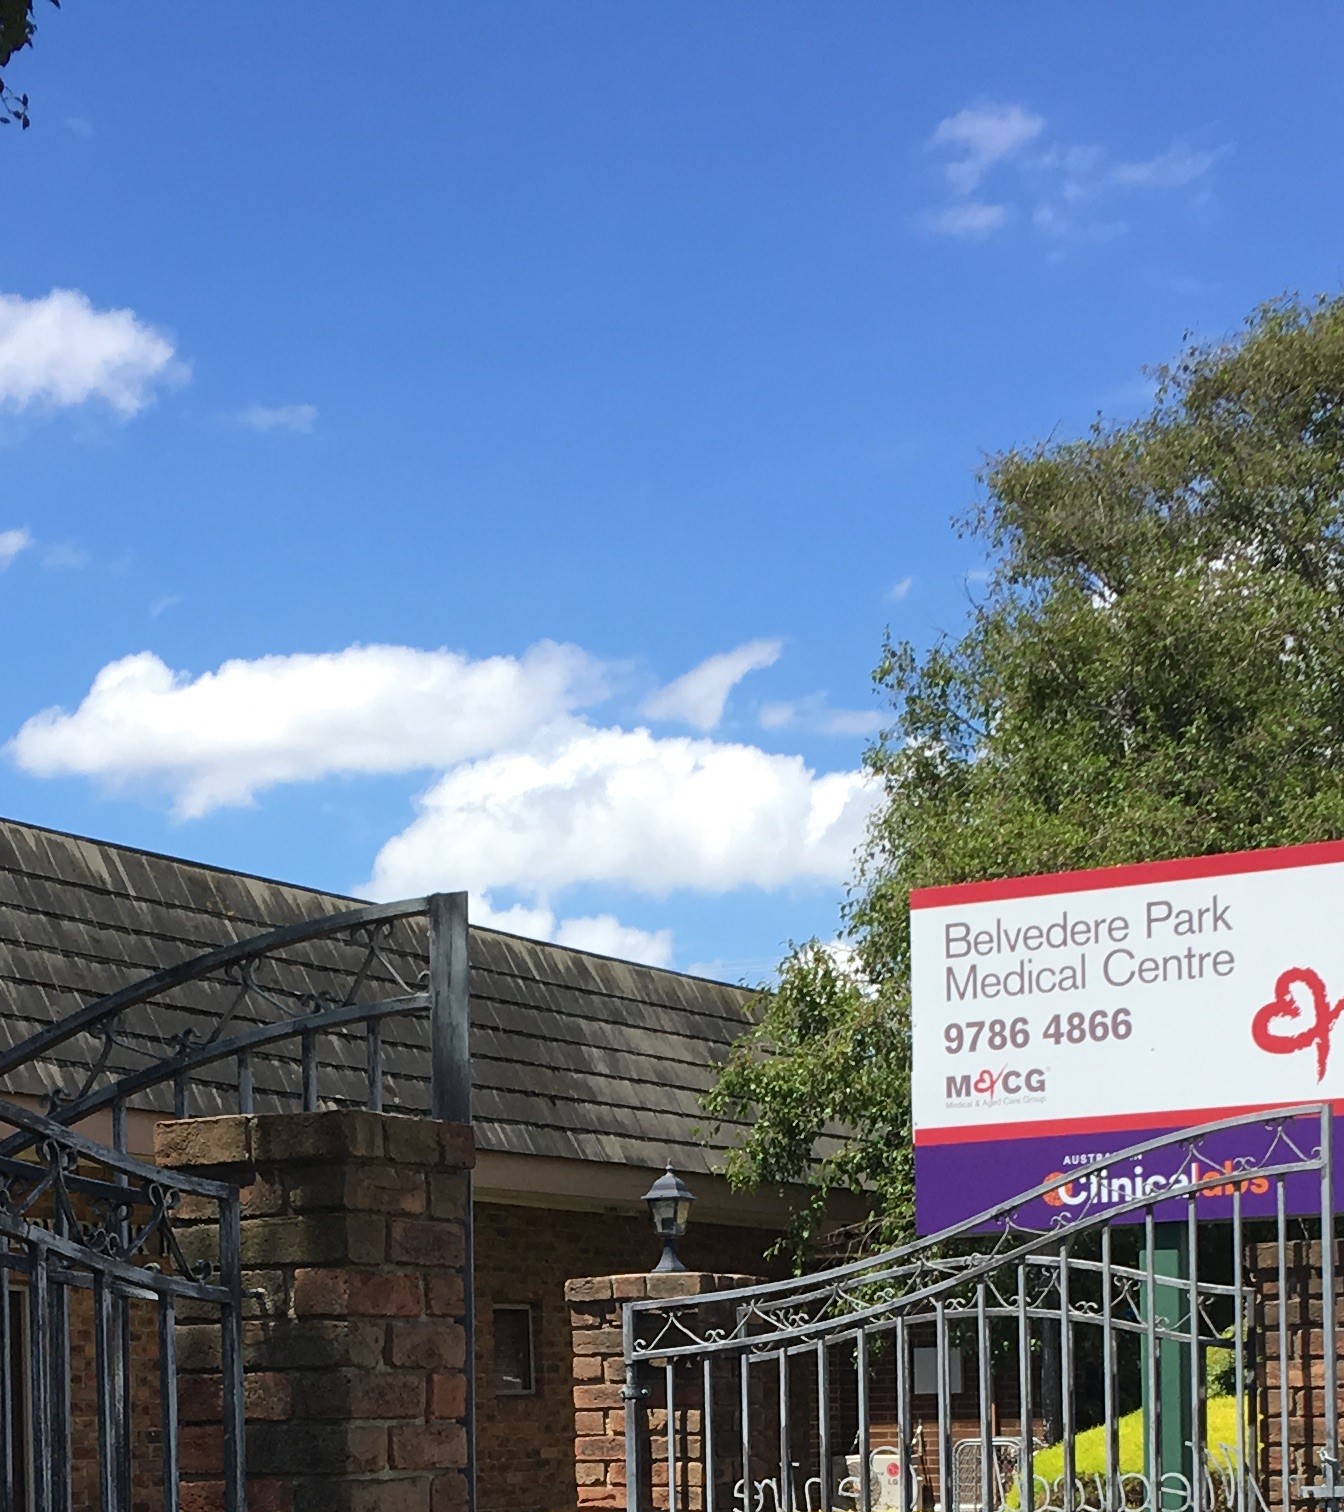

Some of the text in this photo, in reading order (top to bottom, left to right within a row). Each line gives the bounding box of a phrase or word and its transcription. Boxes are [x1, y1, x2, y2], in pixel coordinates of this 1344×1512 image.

[944, 895, 1234, 960] Belvedere Park
[944, 942, 1236, 1003] Medical Centre
[943, 1008, 1133, 1055] 9786 4866
[945, 1100, 973, 1109] Medical
[982, 1098, 1001, 1108] Aged
[1003, 1096, 1021, 1105] Care
[1022, 1095, 1047, 1104] Group
[887, 1478, 899, 1486] LG
